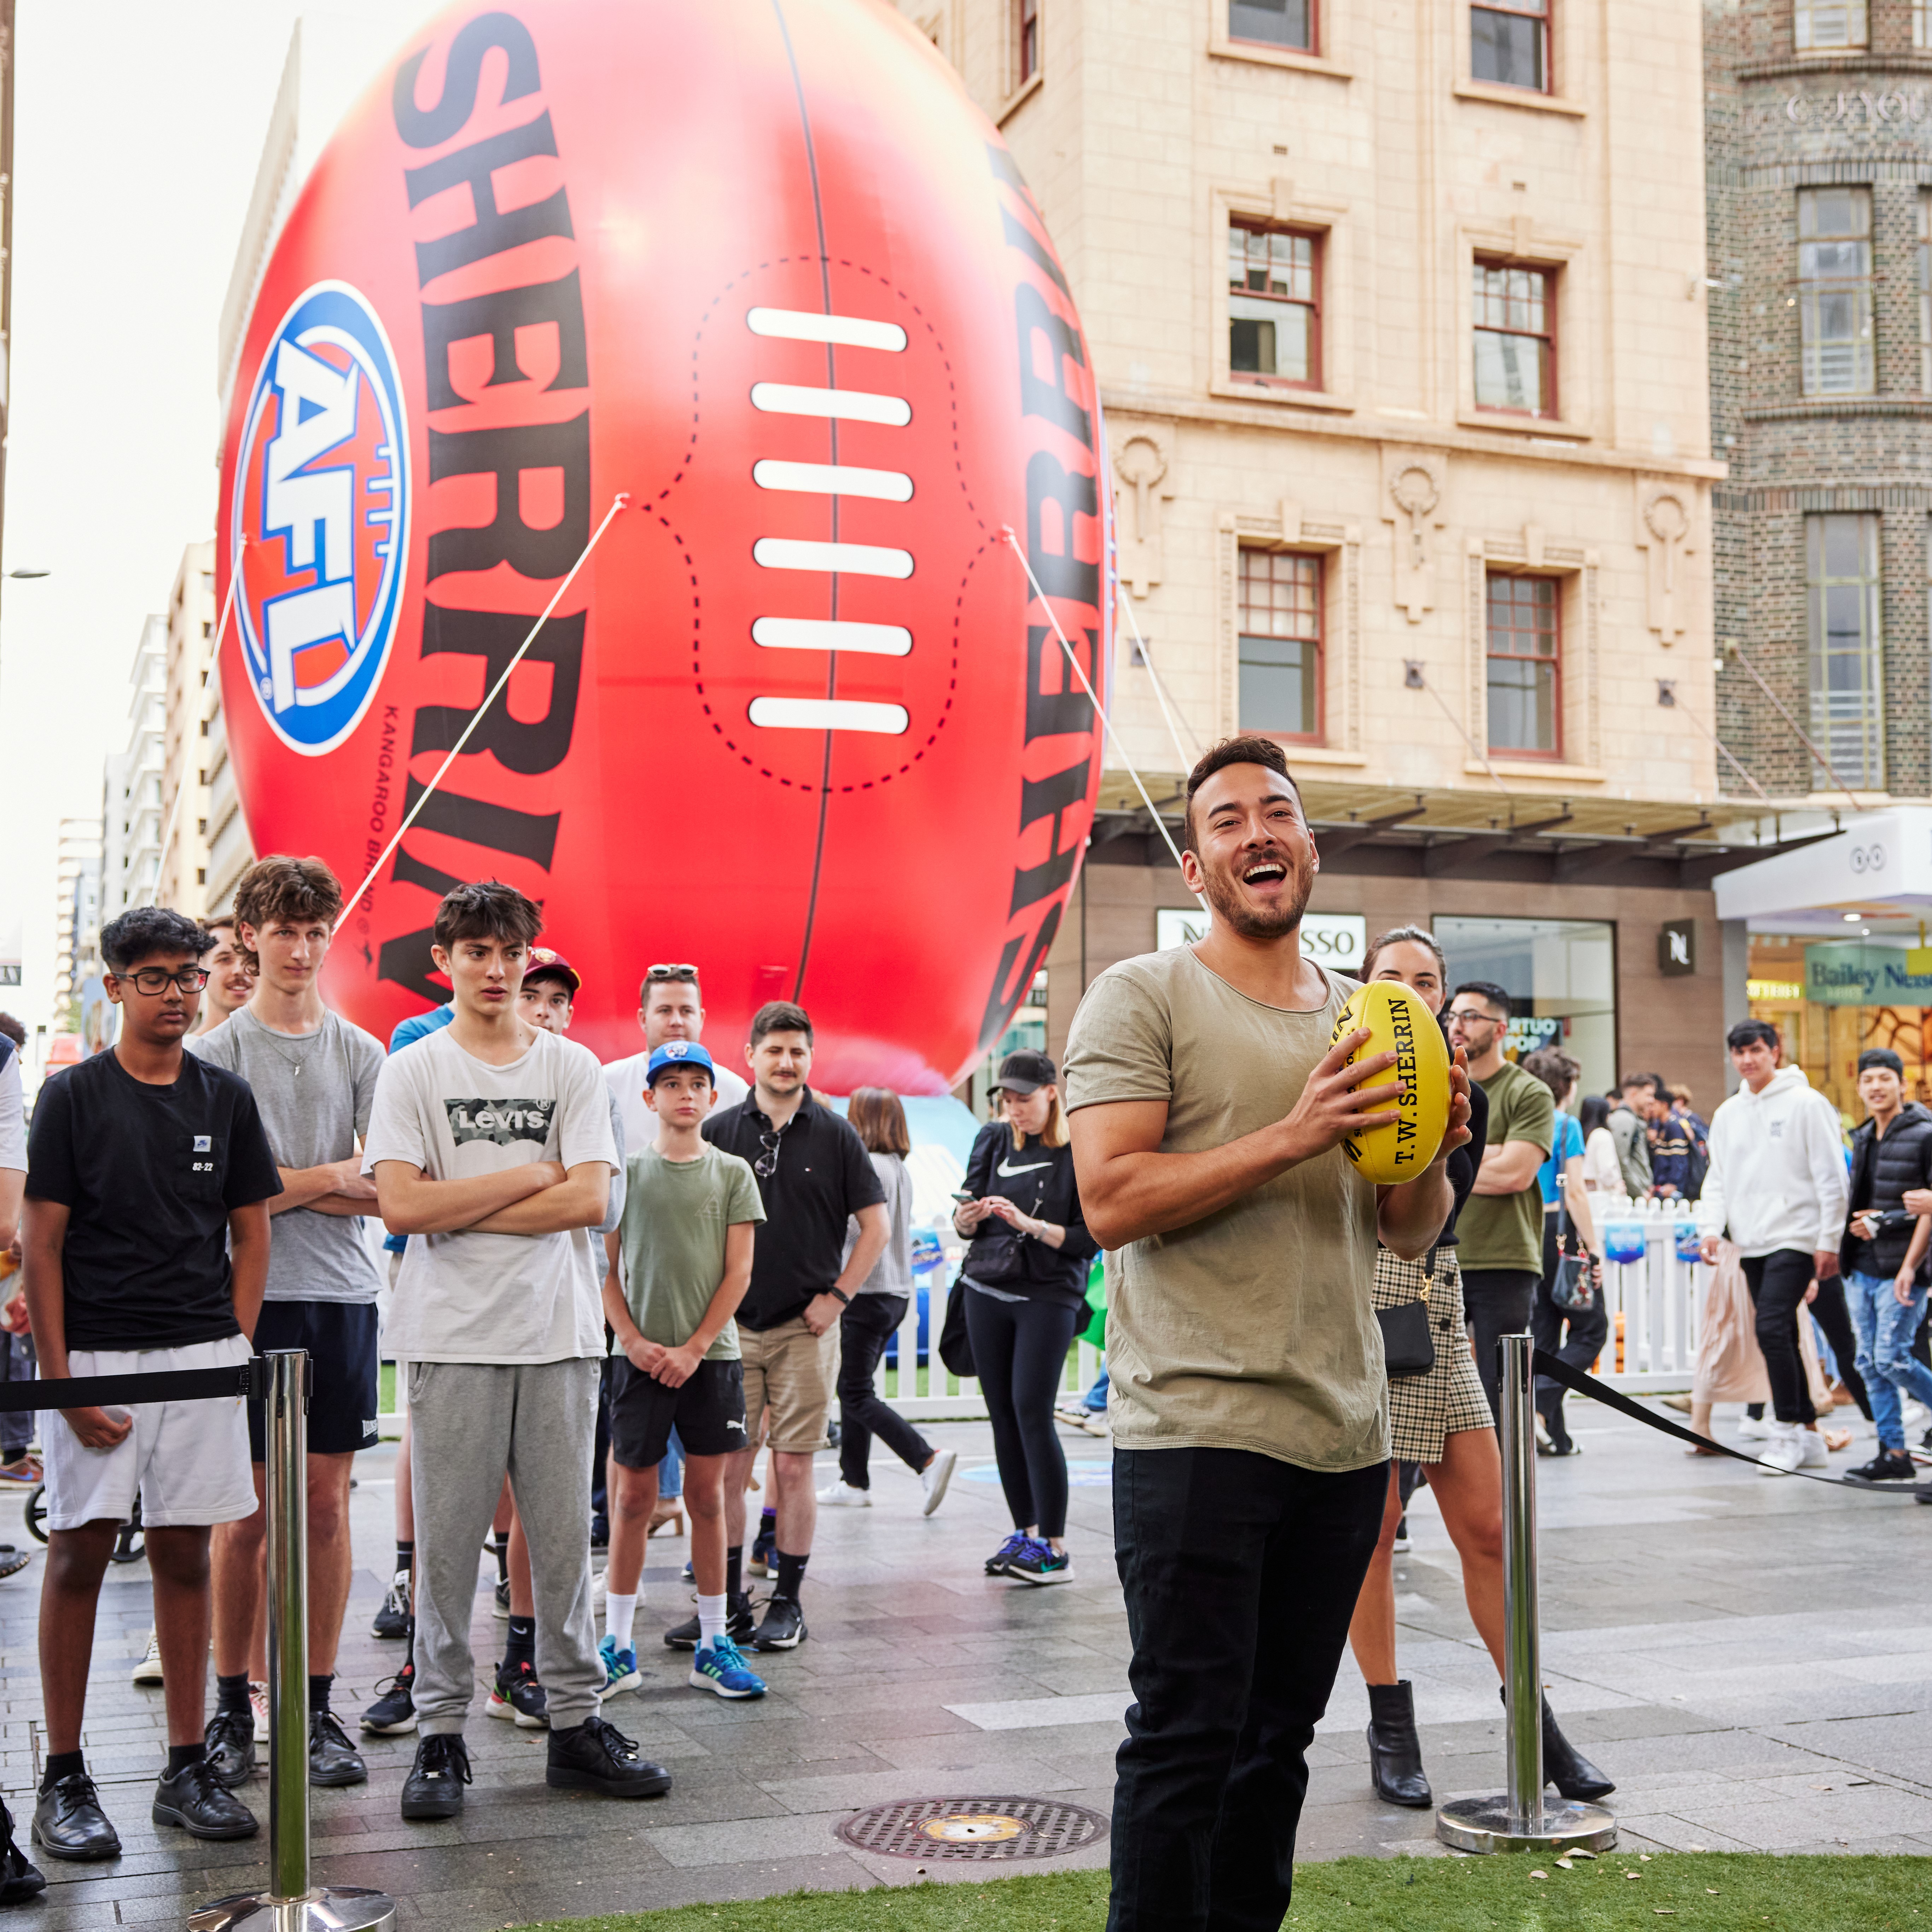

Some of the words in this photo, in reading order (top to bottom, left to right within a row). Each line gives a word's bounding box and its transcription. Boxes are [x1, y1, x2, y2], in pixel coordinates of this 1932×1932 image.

[266, 338, 358, 714] AFL
[371, 704, 400, 833] KANGAROO
[359, 839, 383, 913] BRND
[1811, 962, 1879, 995] Bailey
[192, 1162, 214, 1171] 82-22
